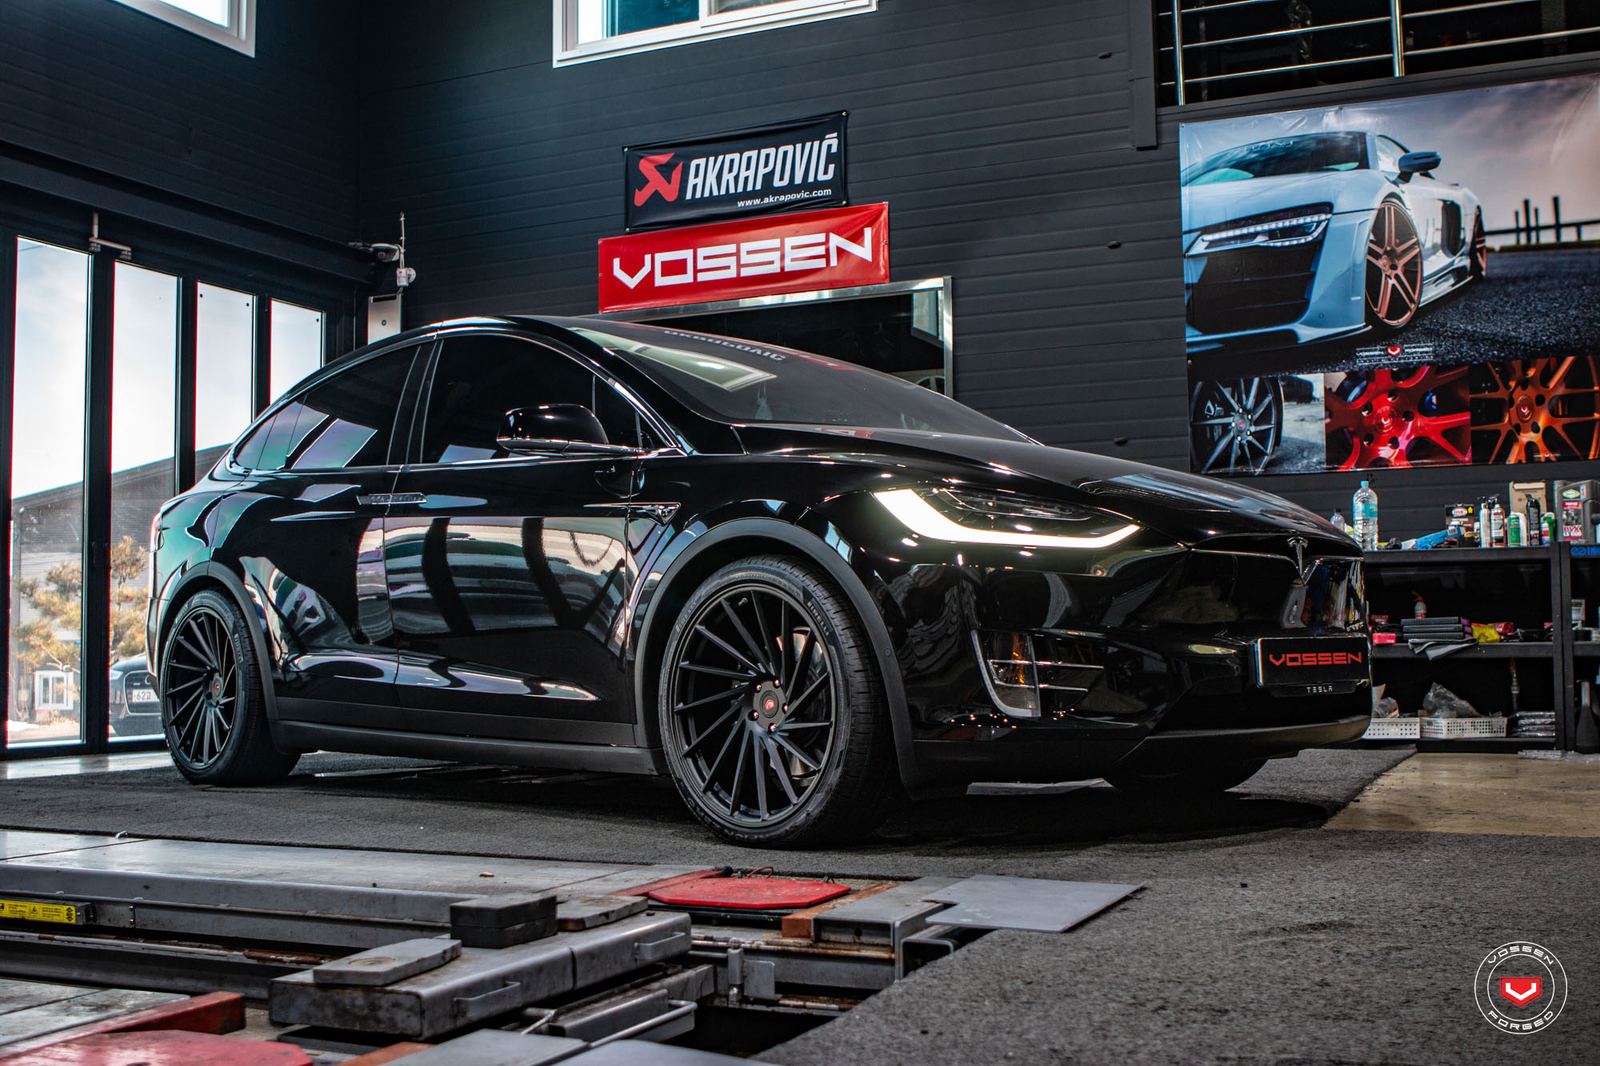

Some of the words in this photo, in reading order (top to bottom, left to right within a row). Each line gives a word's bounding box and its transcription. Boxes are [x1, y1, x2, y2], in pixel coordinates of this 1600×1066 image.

[737, 188, 832, 208] www.akrapovic.com
[613, 227, 873, 290] VOSSEN
[1269, 652, 1362, 666] VOSSEN
[1306, 685, 1333, 693] TESLA
